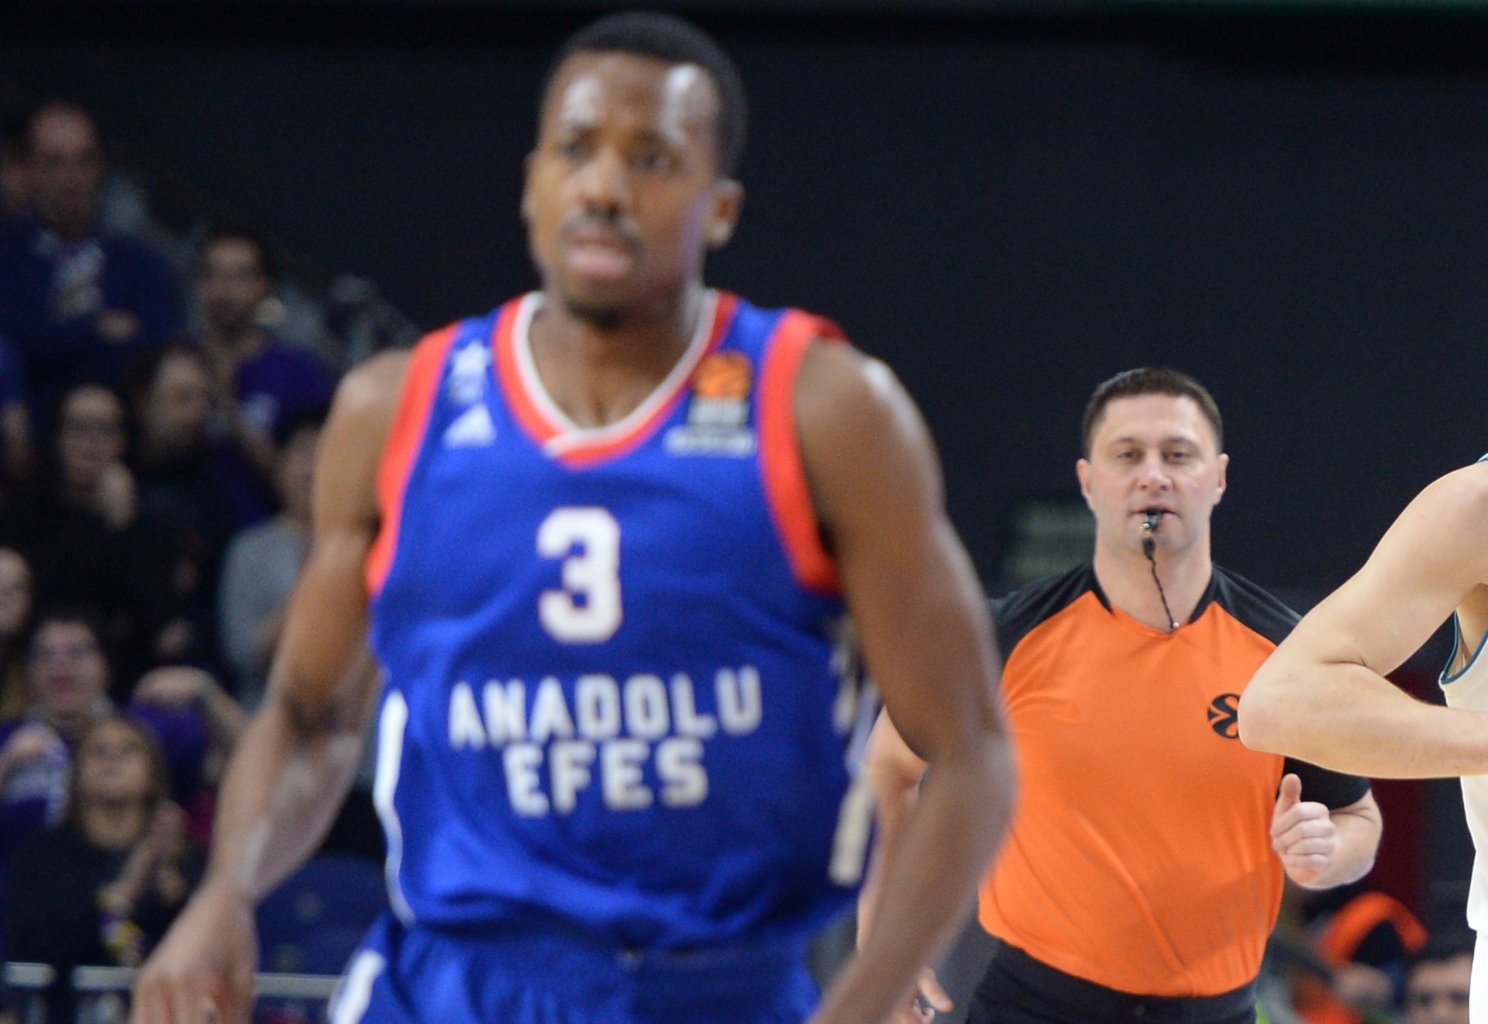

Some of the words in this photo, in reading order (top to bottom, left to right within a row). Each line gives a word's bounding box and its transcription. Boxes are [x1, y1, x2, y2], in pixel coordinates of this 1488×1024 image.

[537, 506, 622, 643] 3
[448, 666, 764, 750] ANADOLU
[504, 736, 708, 818] EFES
